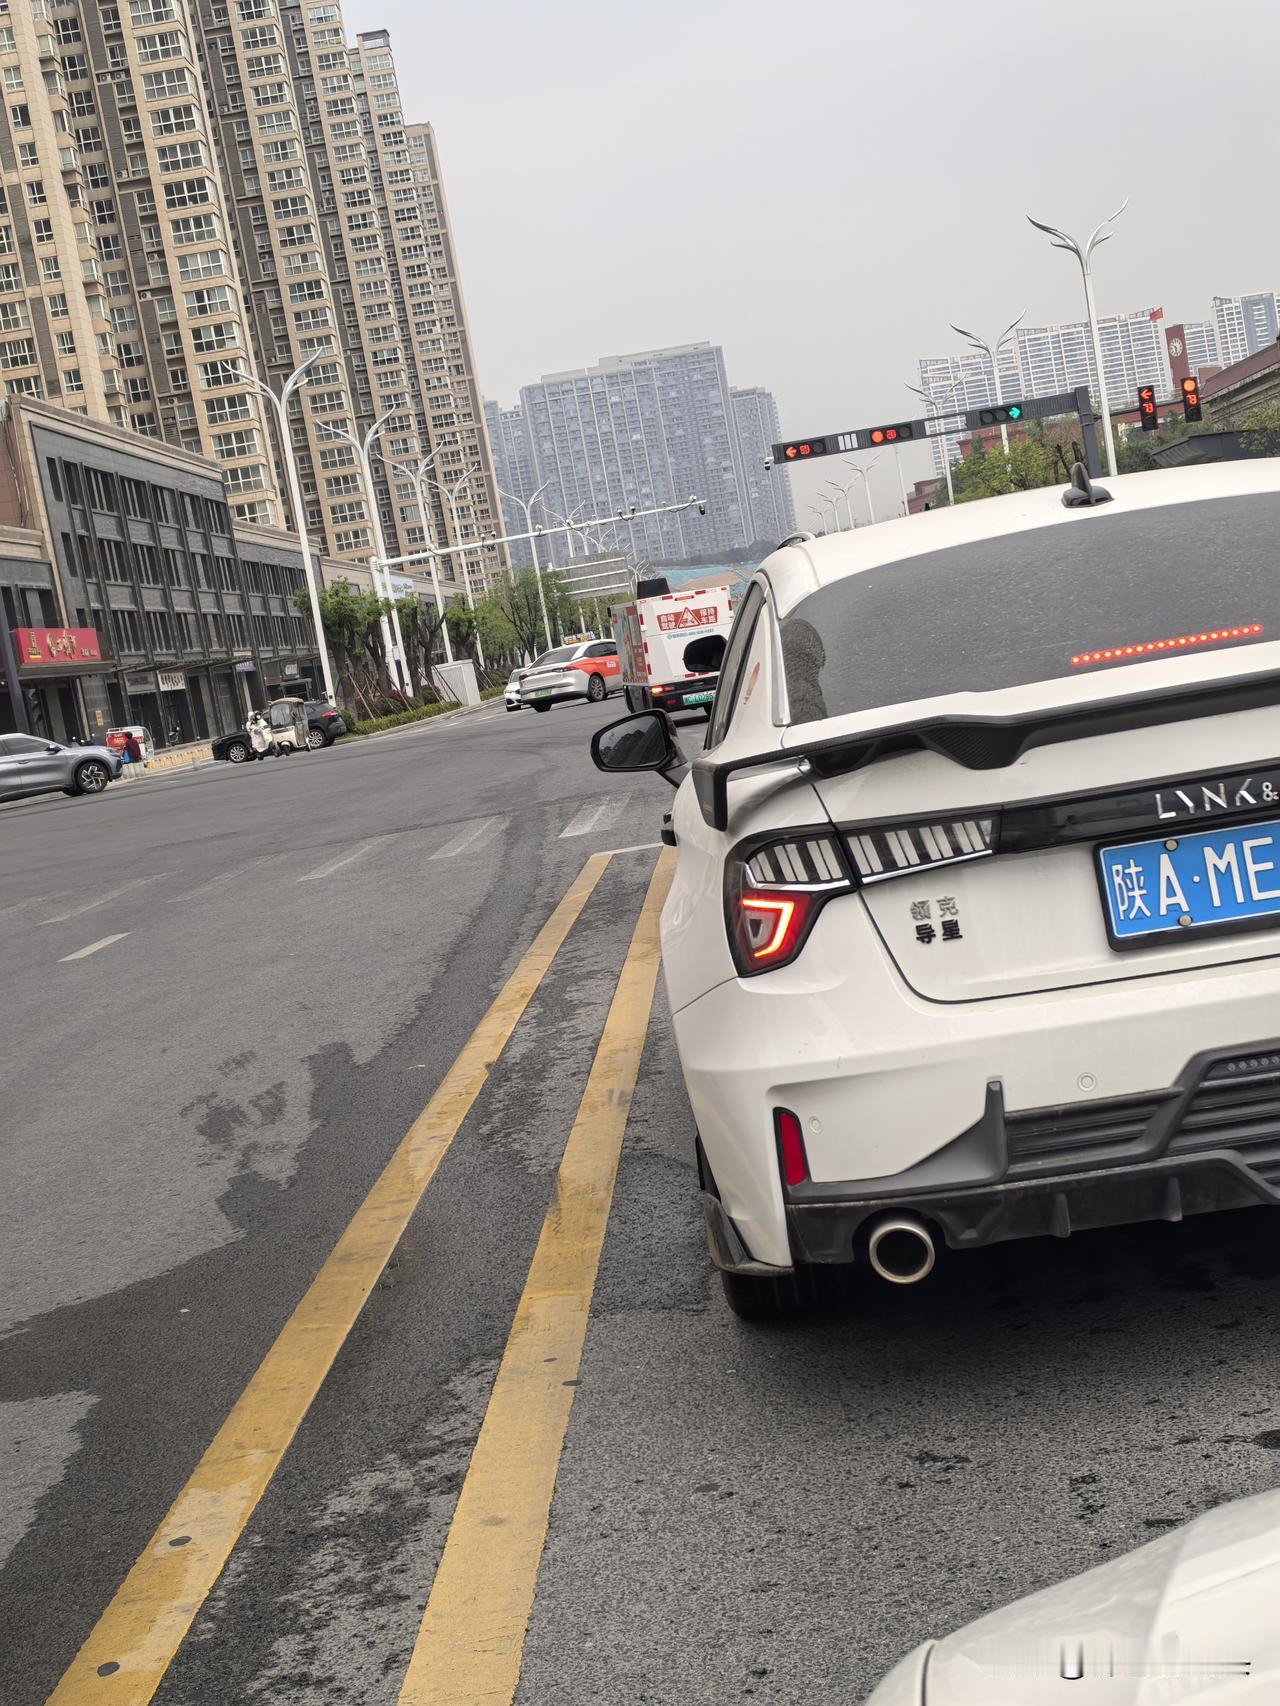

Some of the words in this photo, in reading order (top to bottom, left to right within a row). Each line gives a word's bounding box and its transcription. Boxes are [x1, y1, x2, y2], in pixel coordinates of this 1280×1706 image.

[661, 614, 675, 622] 自动
[700, 608, 715, 616] 保持
[661, 621, 676, 630] 驾驶
[1155, 778, 1257, 819] LYNK
[910, 896, 960, 921] 领克
[915, 919, 963, 944] 导星
